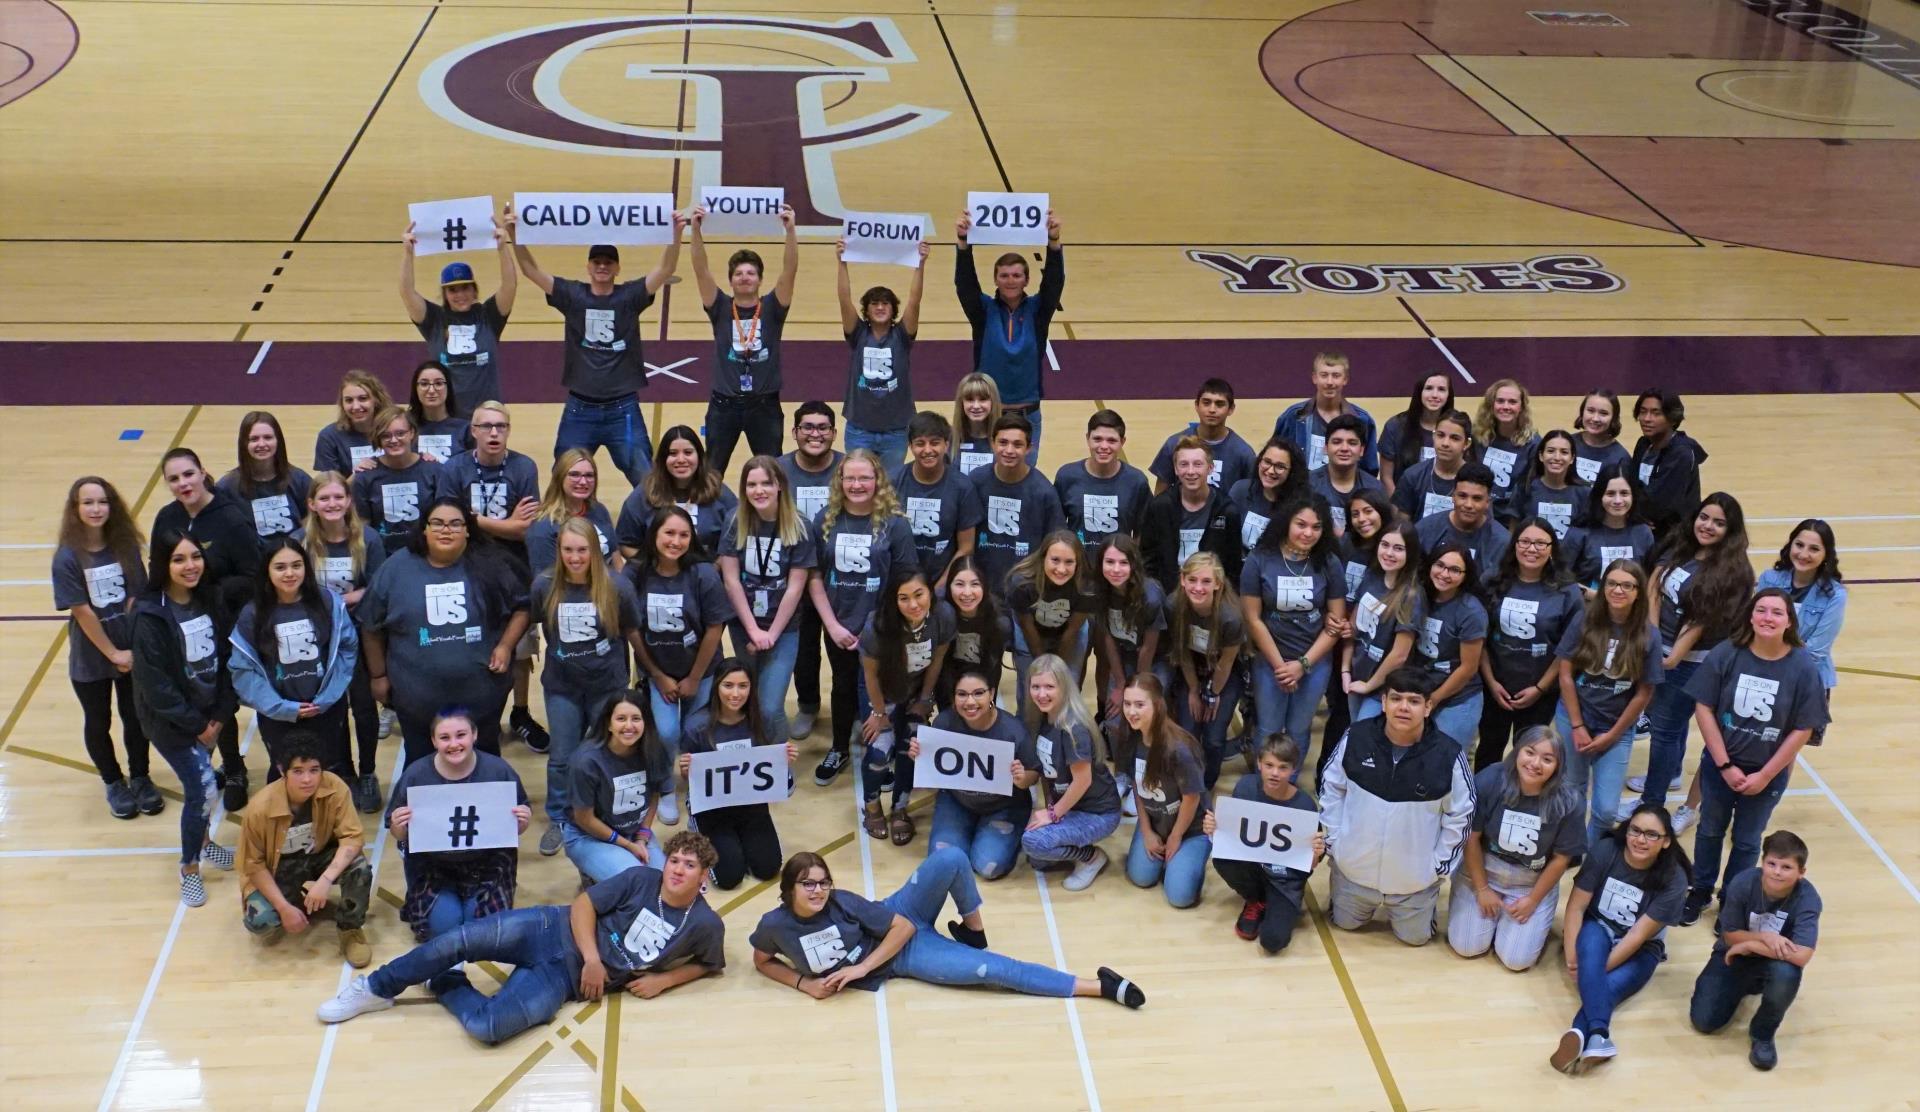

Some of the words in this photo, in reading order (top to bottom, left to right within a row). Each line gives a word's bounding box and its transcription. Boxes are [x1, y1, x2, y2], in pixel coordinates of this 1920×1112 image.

[522, 204, 591, 227] CALD
[597, 205, 669, 227] WELL
[705, 196, 780, 215] YOUTH
[975, 204, 1042, 229] 2019
[443, 218, 467, 250] #
[847, 220, 921, 242] FORUM
[1186, 250, 1626, 294] YOTES
[908, 510, 939, 537] US
[988, 508, 1019, 536] US
[1084, 506, 1118, 533] US
[834, 545, 870, 573] US
[426, 594, 468, 625] US
[1500, 610, 1536, 639] US
[1734, 687, 1775, 721] US
[704, 761, 774, 797] IT'S
[933, 746, 995, 781] ON
[613, 785, 646, 815] US
[448, 805, 480, 847] #
[1239, 816, 1293, 852] US
[1498, 823, 1539, 856] US
[1598, 891, 1638, 927] US
[624, 922, 668, 962] US
